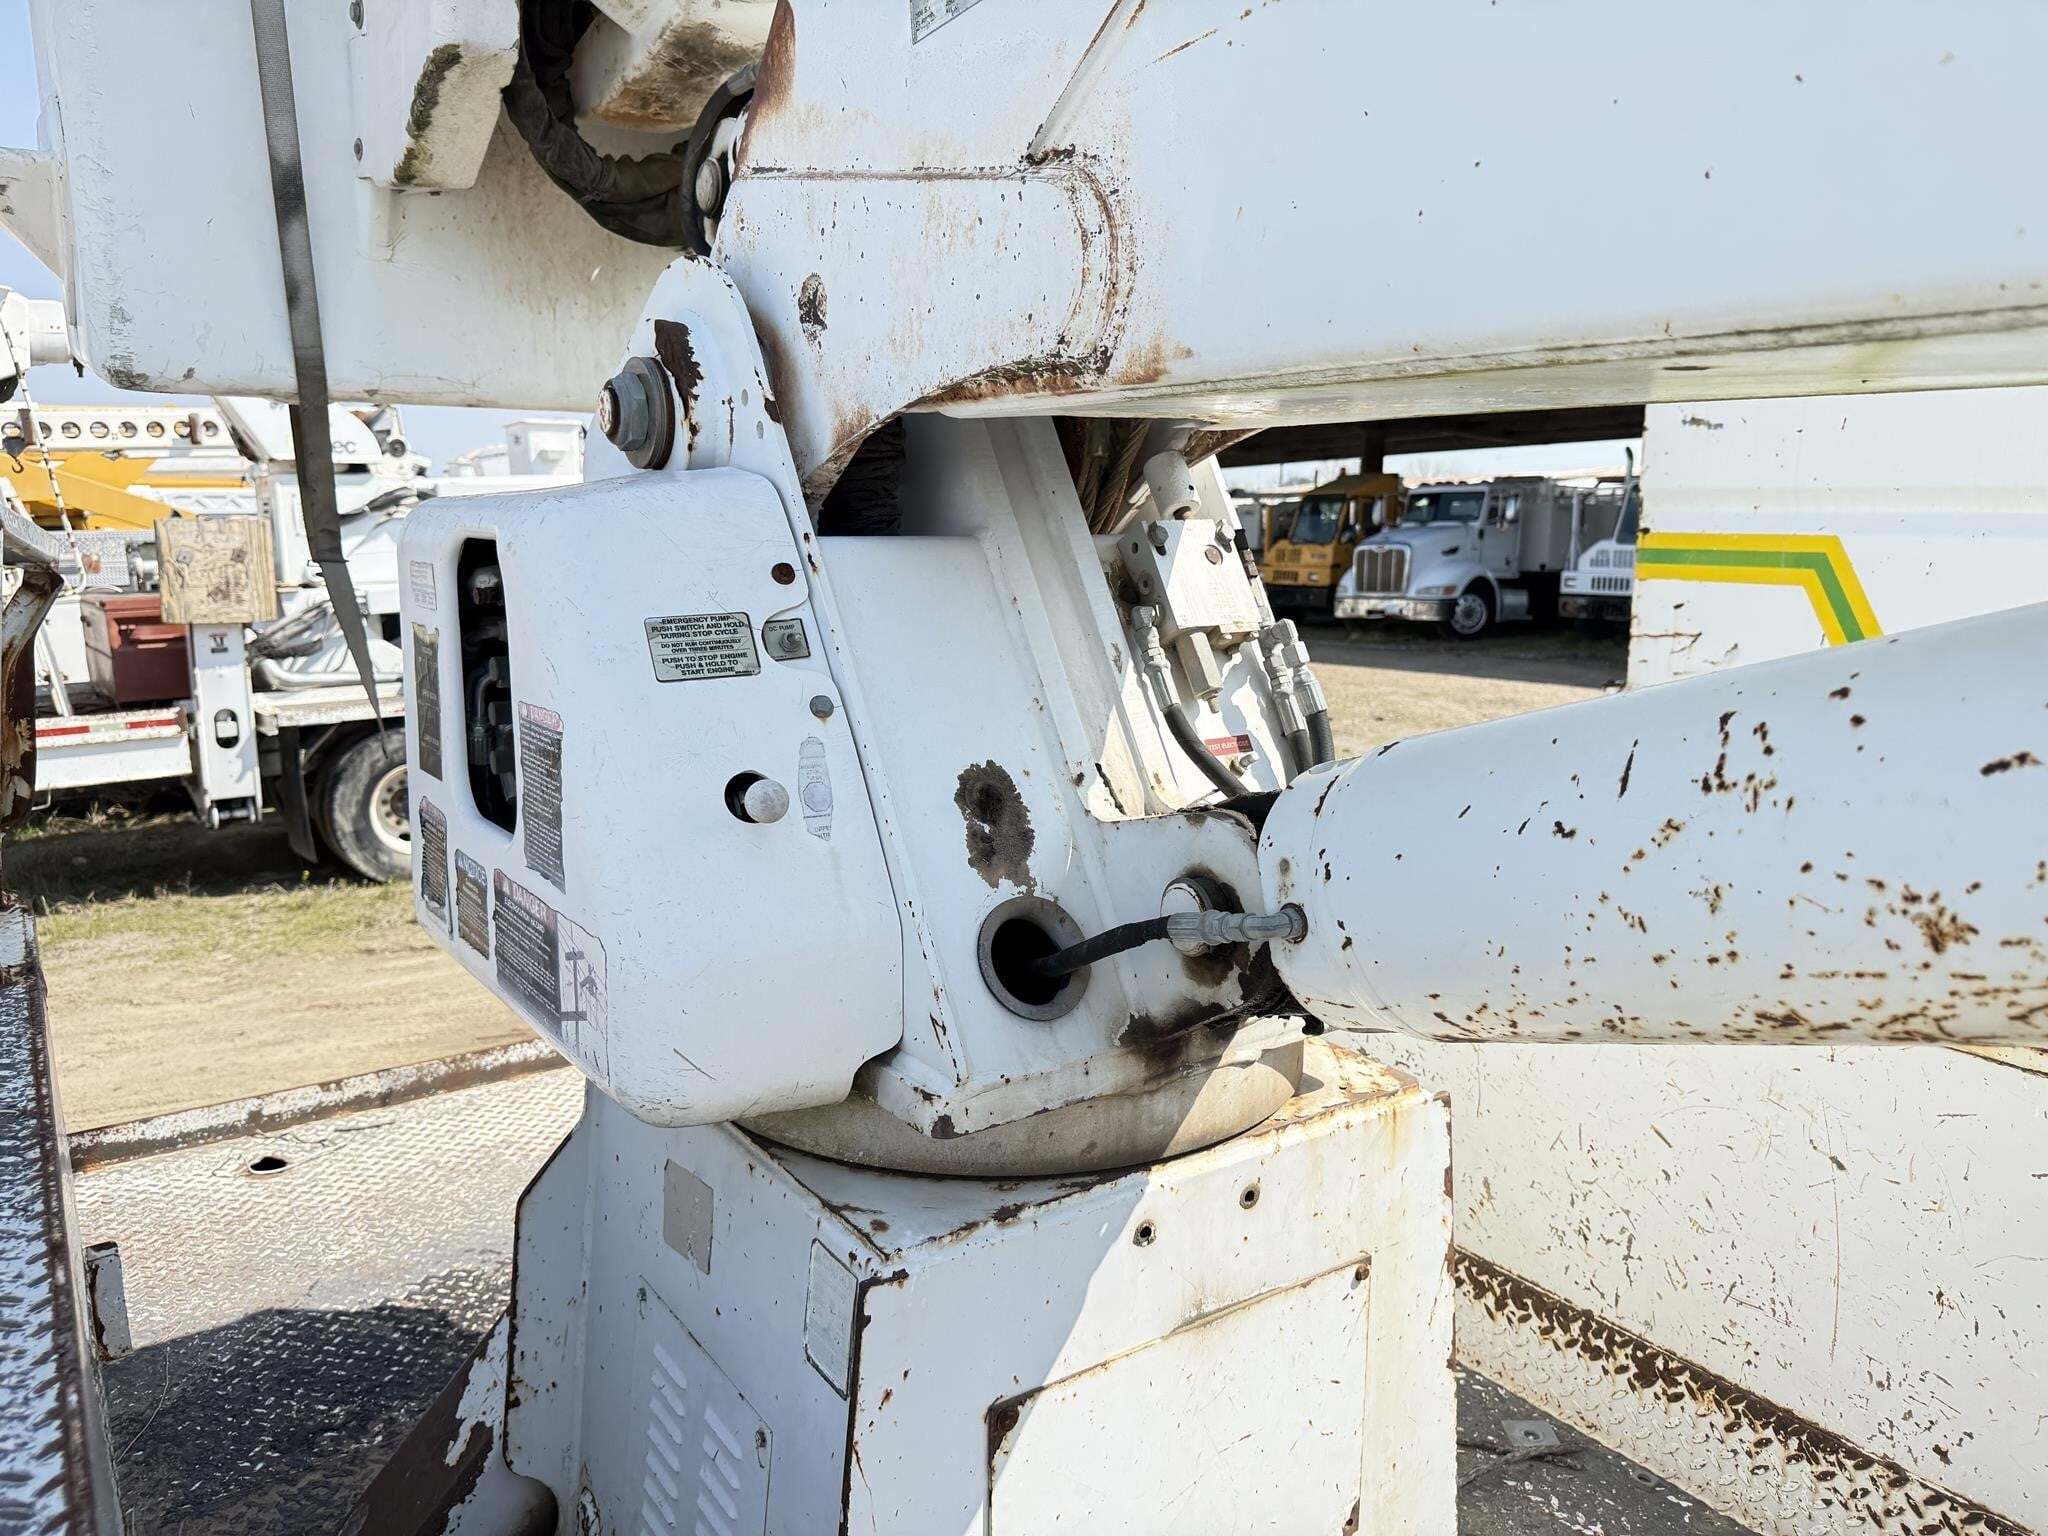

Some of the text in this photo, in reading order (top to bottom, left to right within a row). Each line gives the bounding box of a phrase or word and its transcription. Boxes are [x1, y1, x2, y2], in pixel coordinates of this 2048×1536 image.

[714, 628, 739, 636] CYCLE
[698, 638, 741, 646] CONTINUOUSLY
[697, 654, 718, 662] STOP
[719, 652, 749, 660] ENGINE
[674, 662, 697, 670] PUSH
[512, 882, 547, 922] DANGER
